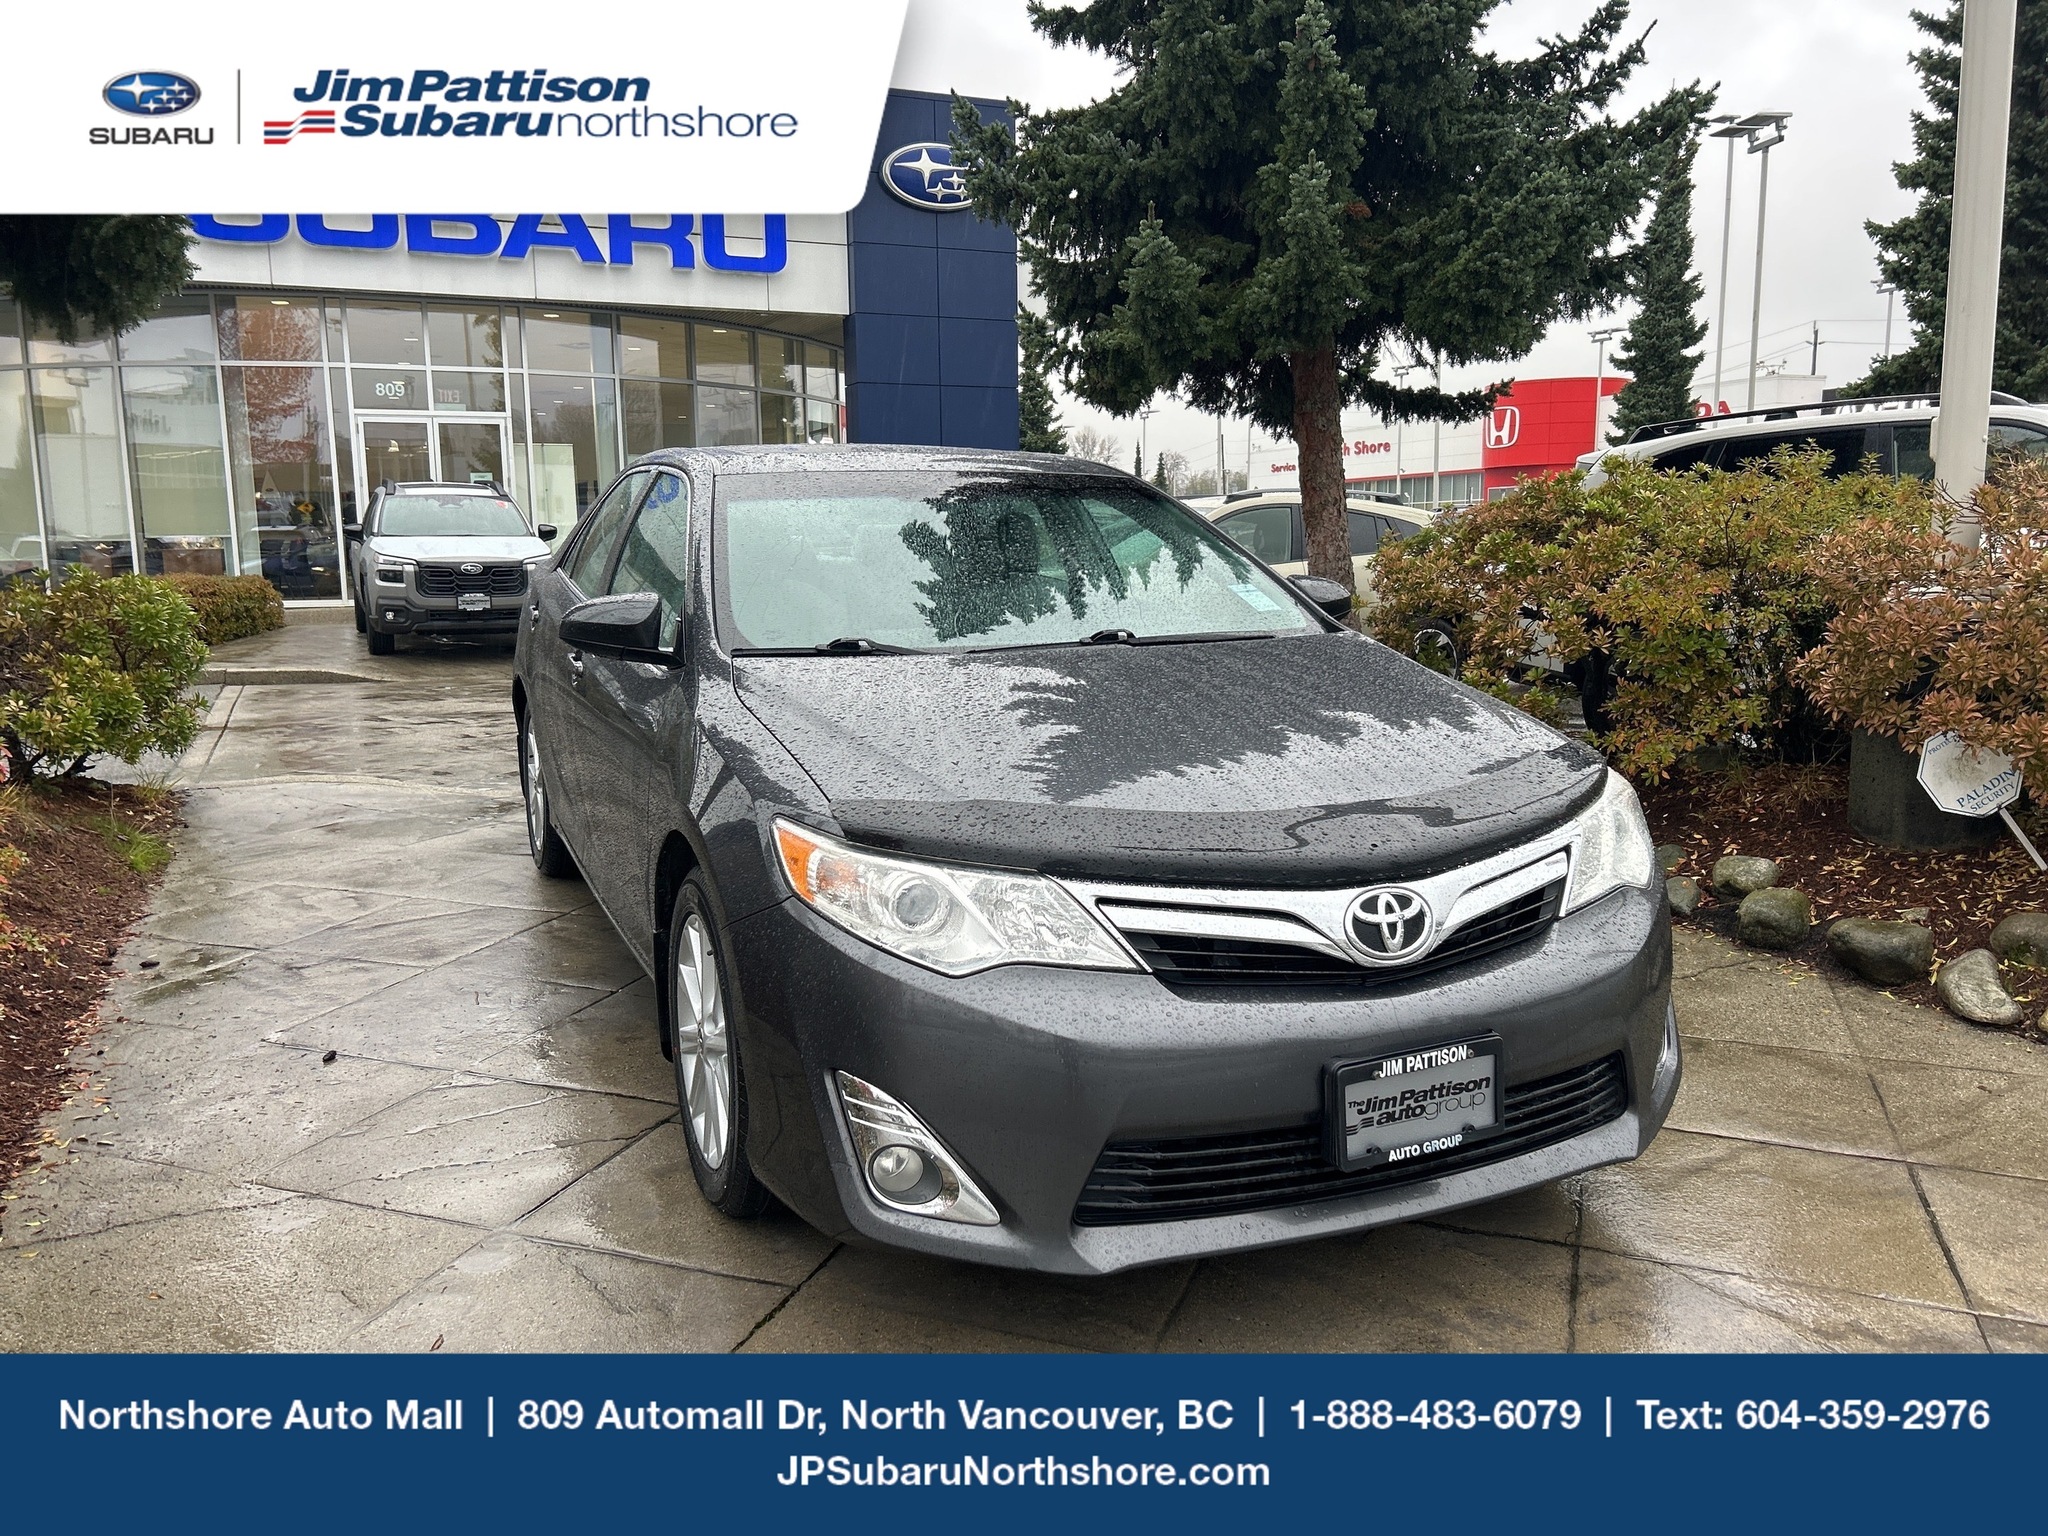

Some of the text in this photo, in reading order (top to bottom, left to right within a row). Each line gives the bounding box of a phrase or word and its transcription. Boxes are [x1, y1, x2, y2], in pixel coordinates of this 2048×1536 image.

[187, 215, 788, 274] BARU
[375, 383, 405, 397] 809
[1354, 440, 1391, 456] Shore
[1271, 462, 1297, 473] Service
[1956, 768, 2016, 808] PALADIN
[1970, 781, 2015, 812] SECURITY
[1379, 1044, 1468, 1078] JIM PATTISON
[1356, 1095, 1398, 1116] Jim
[1399, 1076, 1491, 1107] Pattison
[1388, 1133, 1463, 1162] AUTO GROUP
